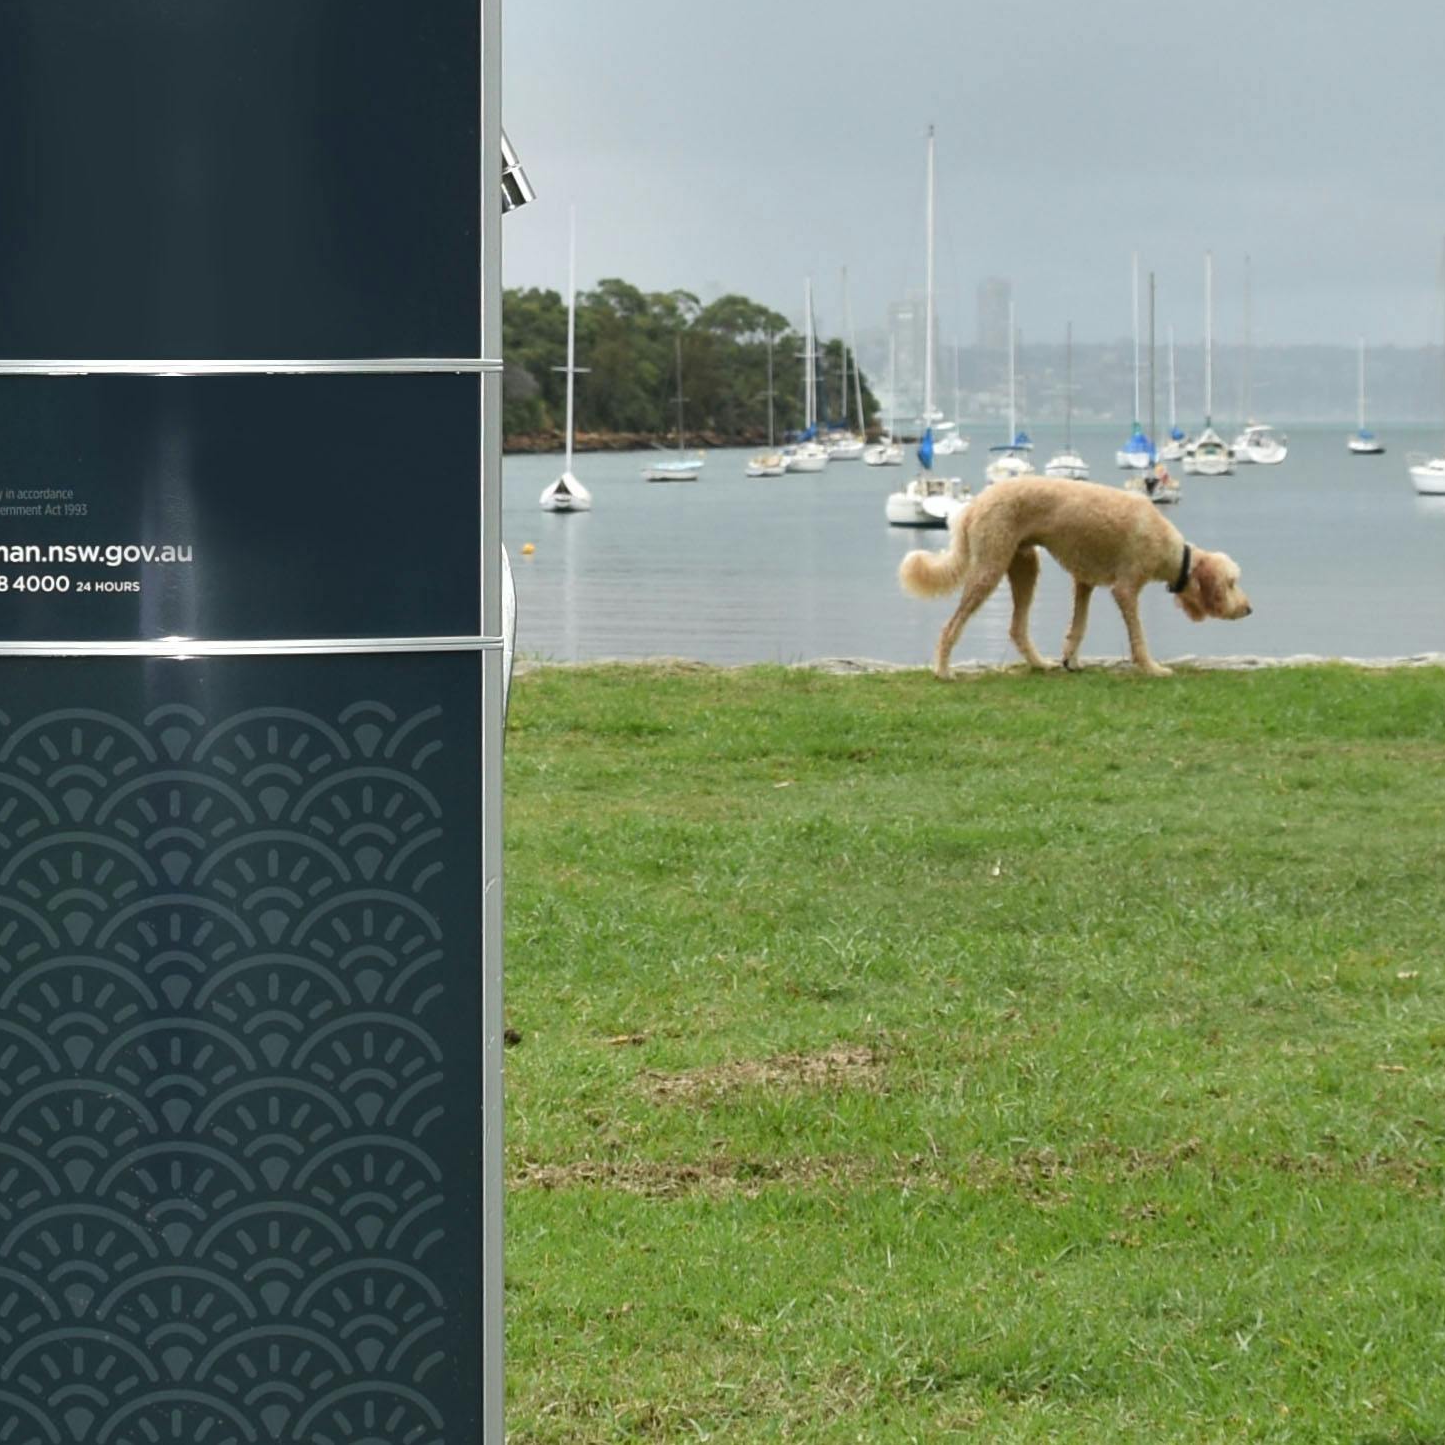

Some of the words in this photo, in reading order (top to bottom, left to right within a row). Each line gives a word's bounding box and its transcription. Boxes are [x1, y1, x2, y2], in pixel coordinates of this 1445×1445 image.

[6, 488, 15, 499] in
[17, 488, 74, 499] accordance
[45, 503, 61, 515] Act
[64, 503, 88, 515] 1993
[12, 575, 70, 592] 4000
[76, 582, 91, 592] 24
[95, 581, 140, 592] HOURS
